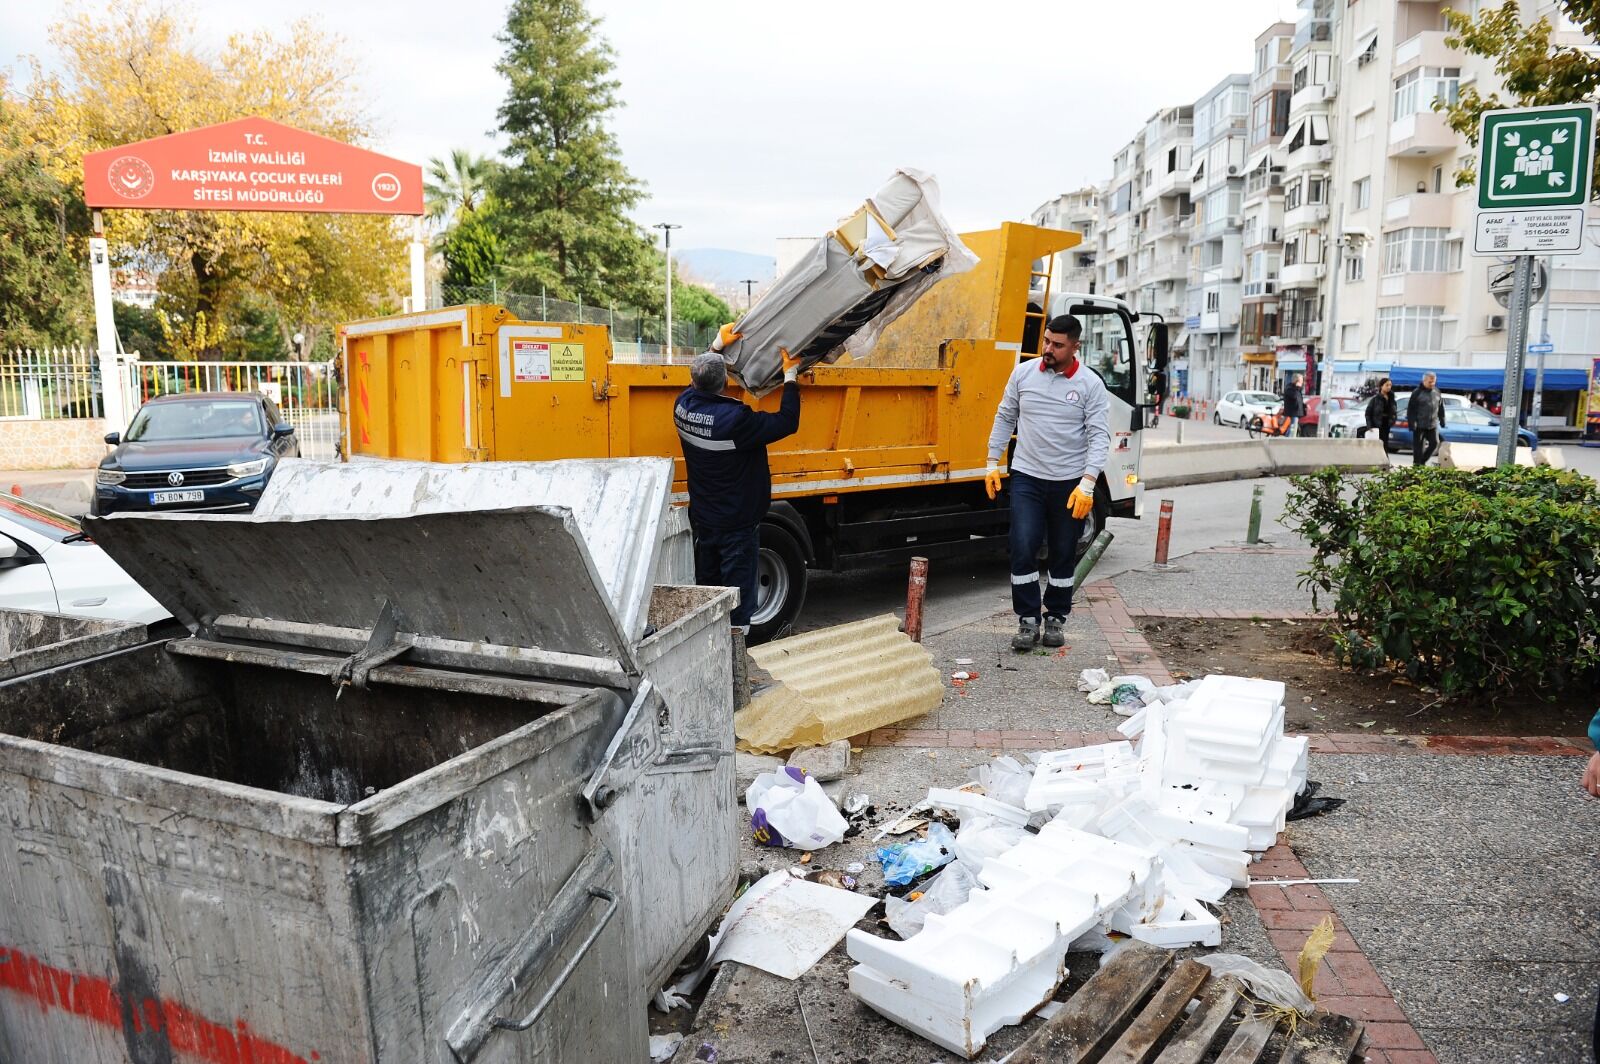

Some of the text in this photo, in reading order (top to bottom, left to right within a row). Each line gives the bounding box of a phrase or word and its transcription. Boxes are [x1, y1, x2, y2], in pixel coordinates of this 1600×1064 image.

[244, 133, 268, 145] T.C.
[208, 149, 306, 166] İZMİR VALİLİĞİ
[171, 169, 343, 186] KARŞIYAKA ÇOCUK EVLERİ
[377, 183, 396, 192] 1923
[193, 187, 324, 203] SİTESİ MÜDÜRLÜĞÜ
[688, 412, 715, 426] BELEDİYESİ
[154, 493, 165, 502] 35
